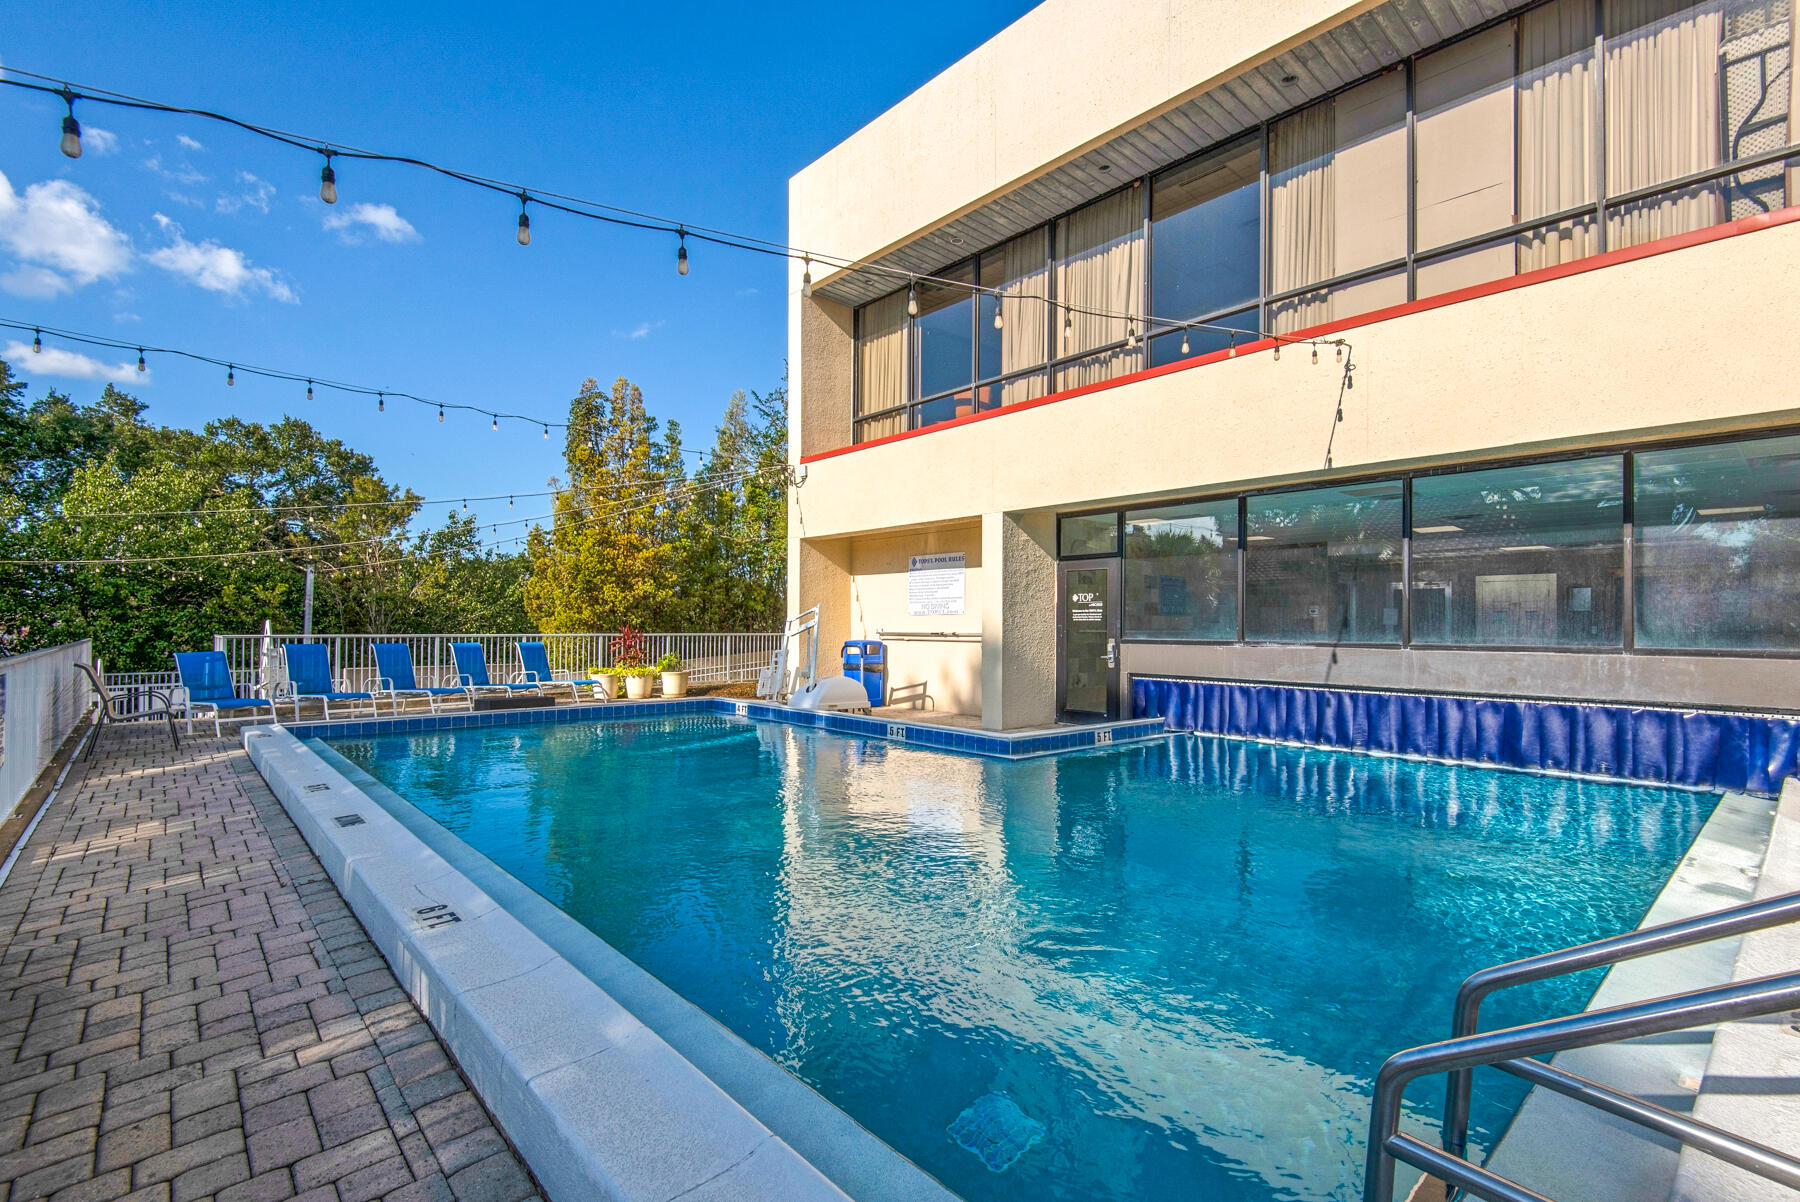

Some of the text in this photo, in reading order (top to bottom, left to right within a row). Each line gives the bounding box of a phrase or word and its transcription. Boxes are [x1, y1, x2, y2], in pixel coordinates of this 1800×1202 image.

[889, 726, 905, 738] 5 FT
[1097, 730, 1112, 743] 5 FT
[416, 904, 463, 929] 6 FT
